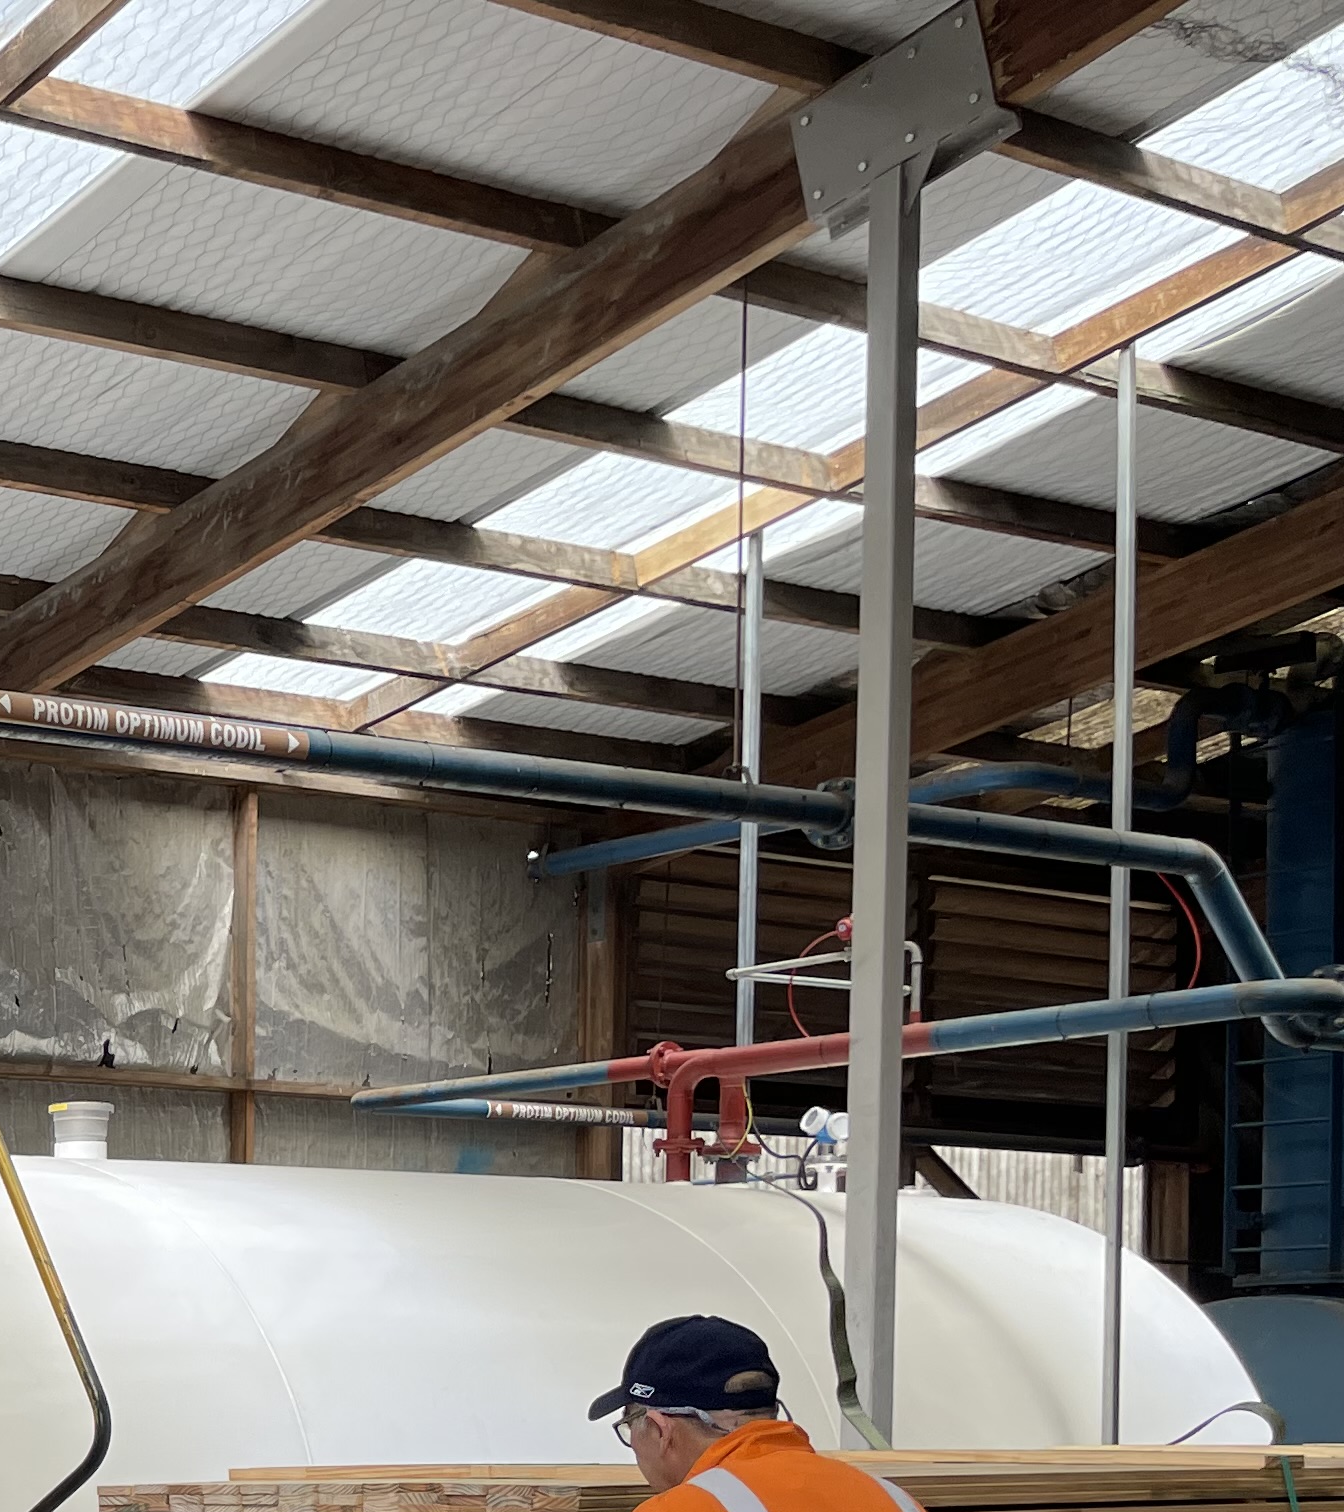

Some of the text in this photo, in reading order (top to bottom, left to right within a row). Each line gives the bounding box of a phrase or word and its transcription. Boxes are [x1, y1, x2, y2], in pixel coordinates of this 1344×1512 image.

[32, 697, 266, 751] PROTIM OPTIMUM CODIL
[512, 1103, 635, 1125] PROTIM OPTIMUM CODIL
